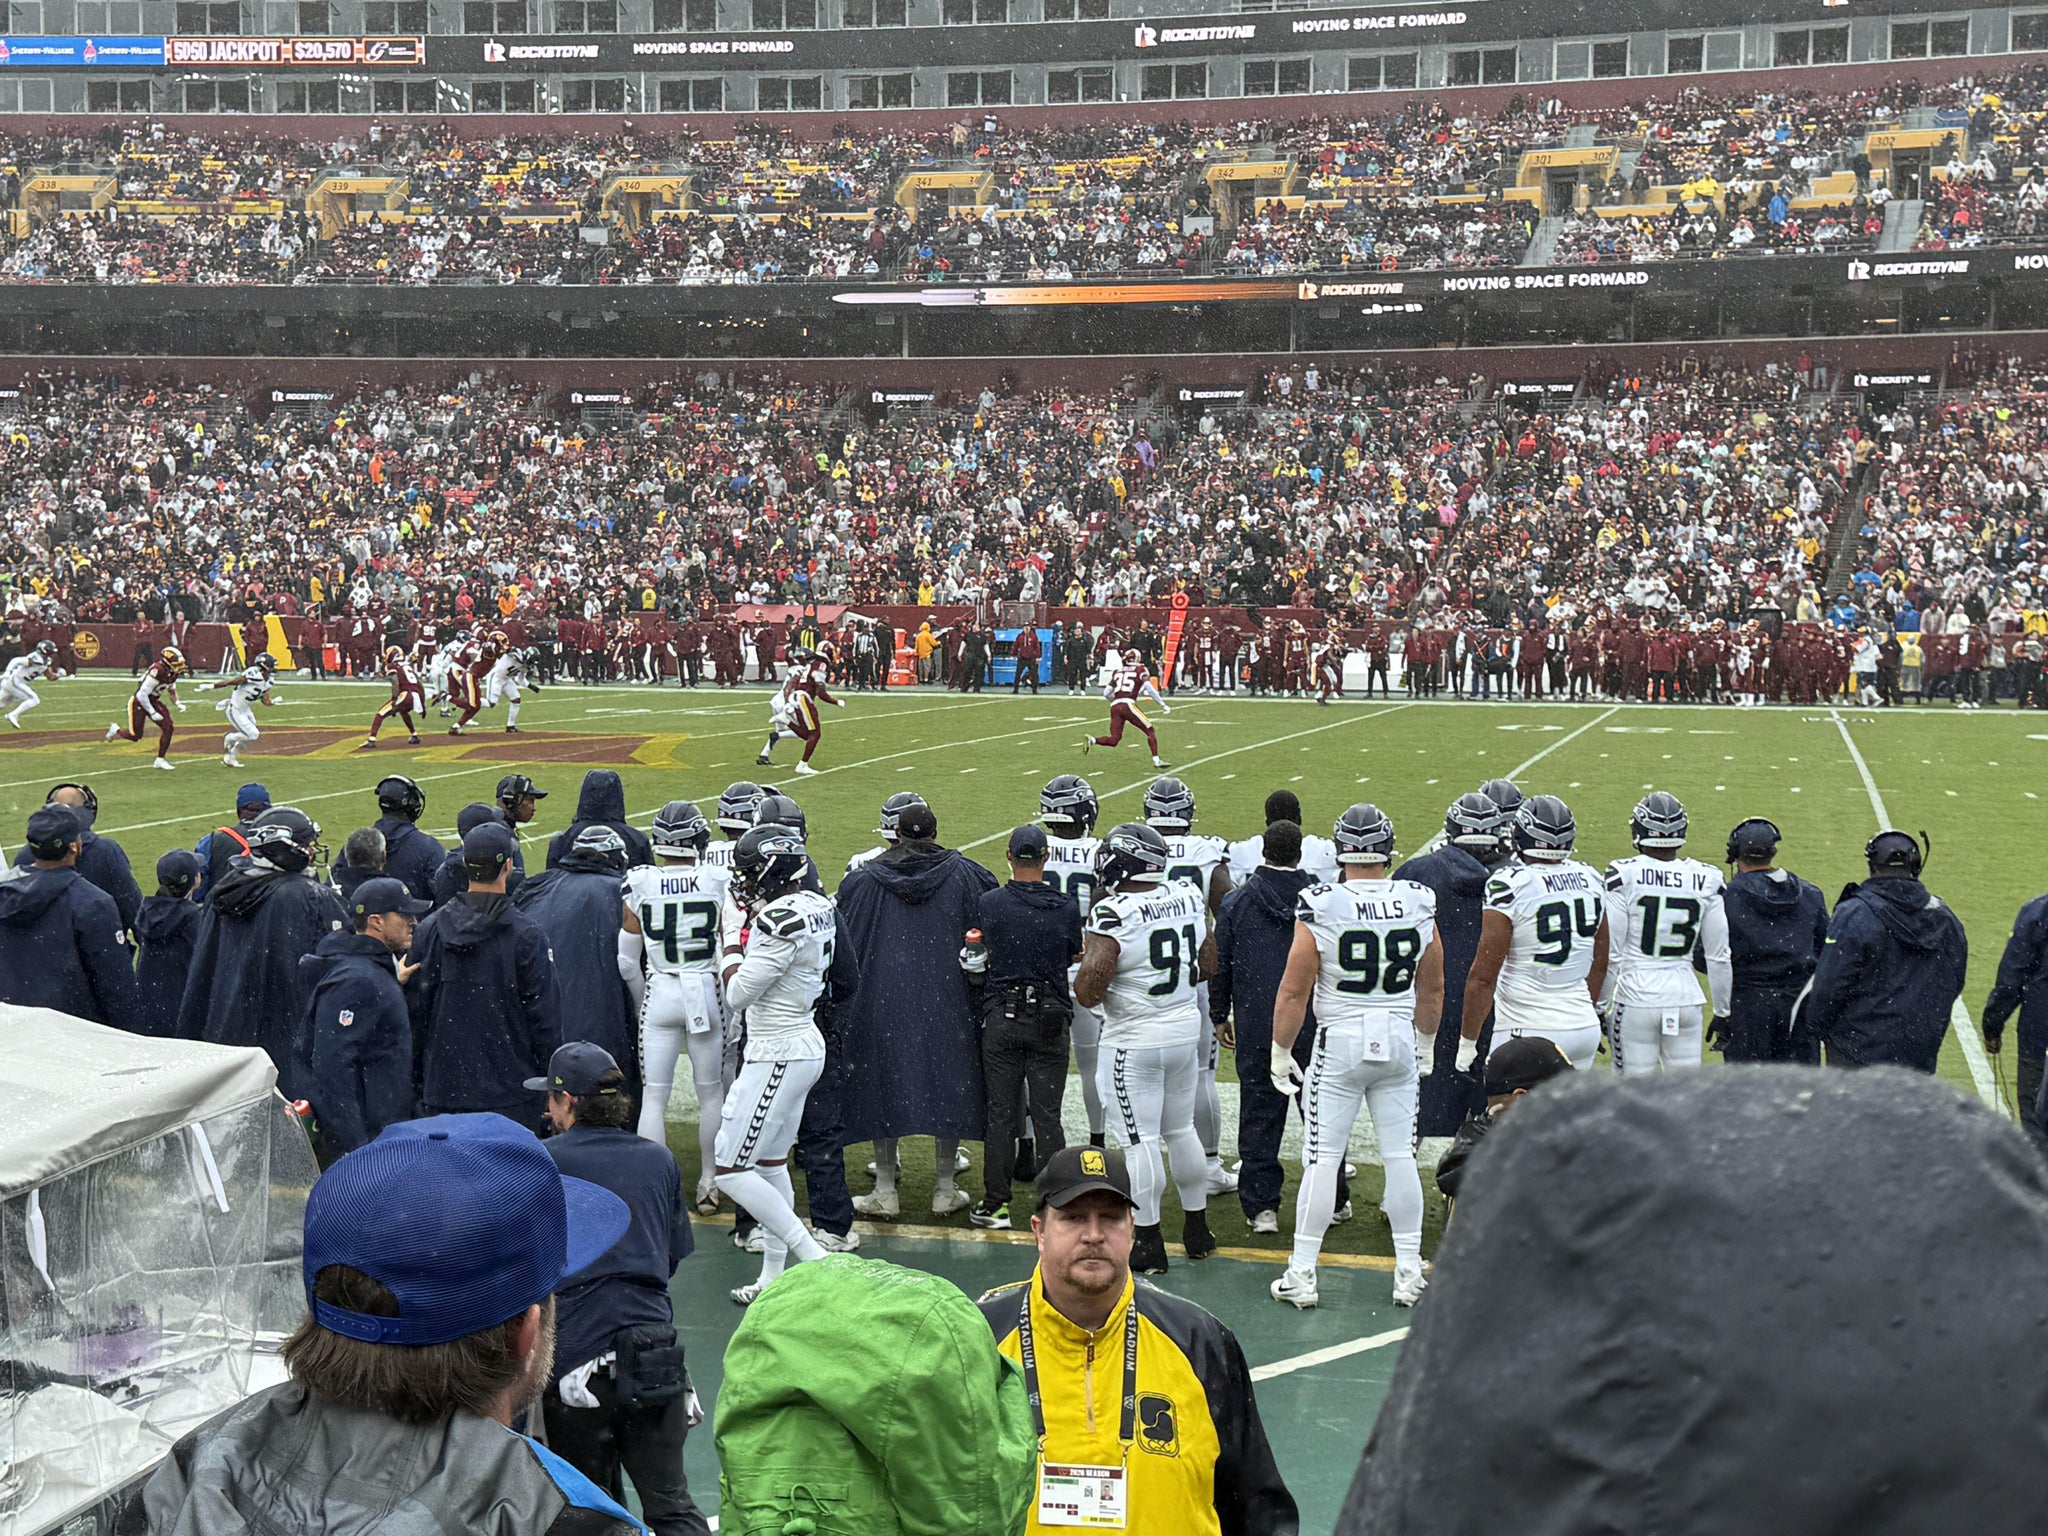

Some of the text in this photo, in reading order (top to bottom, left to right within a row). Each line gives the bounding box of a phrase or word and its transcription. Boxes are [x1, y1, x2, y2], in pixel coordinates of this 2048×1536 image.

[1292, 12, 1467, 33] MOVING SPACE FORWARD
[1160, 25, 1256, 43] ROCKETDYNE
[209, 41, 280, 61] JACKPOT
[294, 41, 352, 61] $20,570
[508, 45, 600, 59] ROCKETDYNE
[633, 40, 794, 55] MOVING SPACE FORWARD
[1873, 260, 1969, 276] ROCKETDYNE
[1320, 283, 1404, 296] ROCKETDYNE
[1443, 271, 1649, 291] MOVING SPACE FORWARD
[1048, 845, 1091, 864] INLEY
[660, 875, 700, 896] HOOK
[1542, 871, 1590, 893] MORRIS
[1636, 867, 1707, 892] JONES IV
[1138, 897, 1187, 924] MURPHY
[1355, 899, 1404, 921] MILLS
[641, 899, 718, 965] 43
[1532, 896, 1602, 967] 94
[1636, 894, 1702, 961] 13
[1148, 922, 1199, 997] 91
[1336, 926, 1421, 995] 98
[1019, 1316, 1035, 1370] STADIUM
[1126, 1319, 1137, 1372] STADIUM
